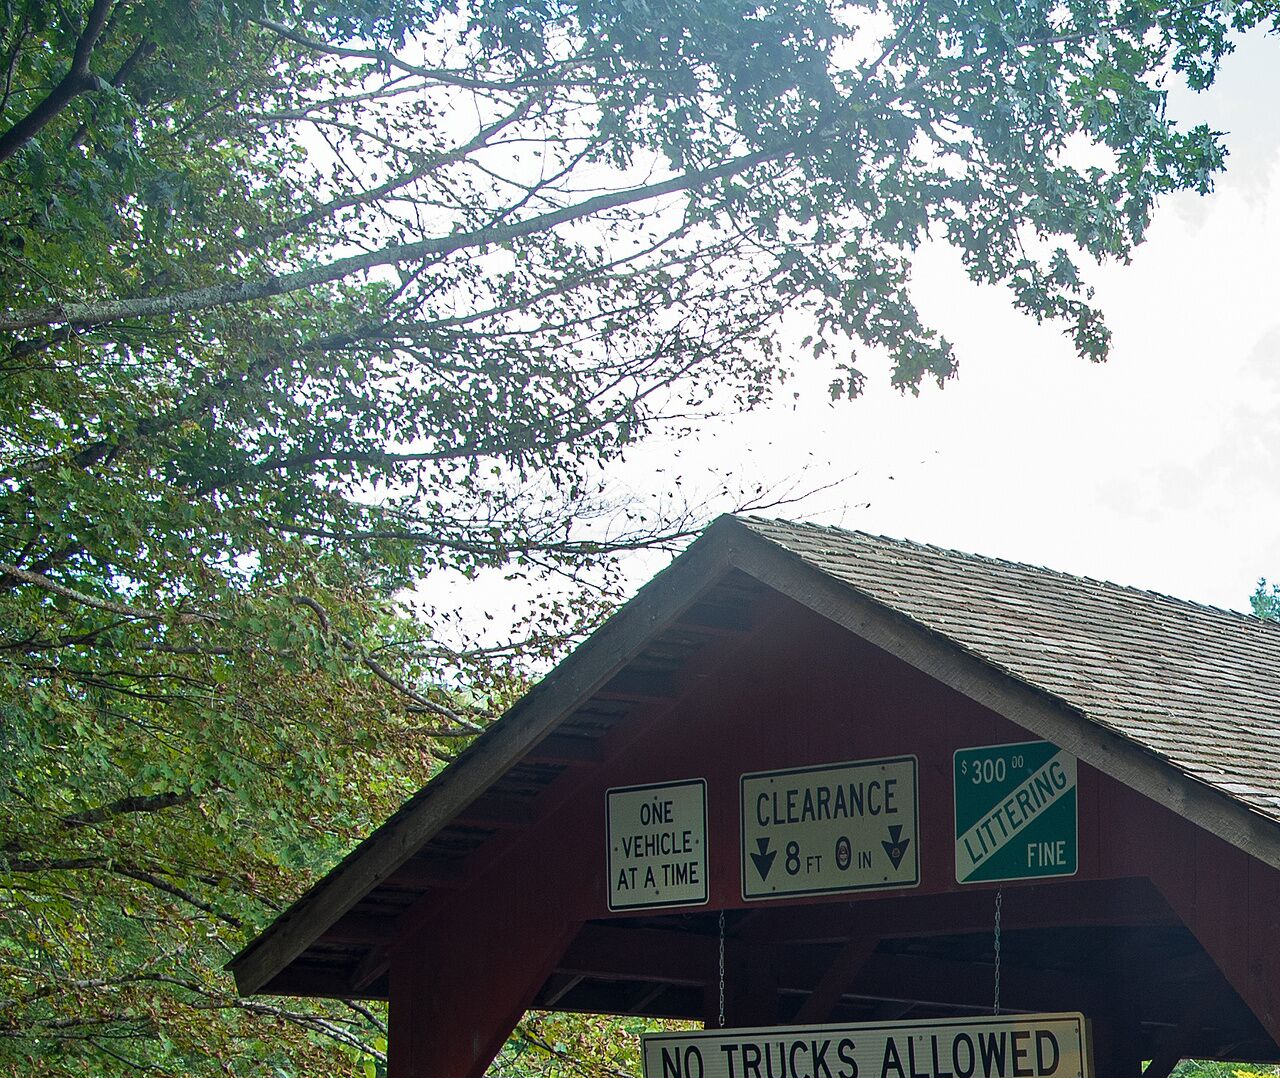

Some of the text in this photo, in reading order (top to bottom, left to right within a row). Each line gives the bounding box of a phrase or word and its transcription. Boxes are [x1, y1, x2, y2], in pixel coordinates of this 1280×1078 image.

[640, 801, 674, 826] ONE
[757, 779, 898, 827] CLEARANCE
[963, 761, 1067, 865] LITTERING
[622, 831, 693, 859] VEHICLE
[785, 841, 801, 876] 8
[806, 855, 823, 874] FT
[858, 851, 872, 869] IN
[1027, 841, 1067, 868] FINE
[617, 861, 699, 891] AT A TIME
